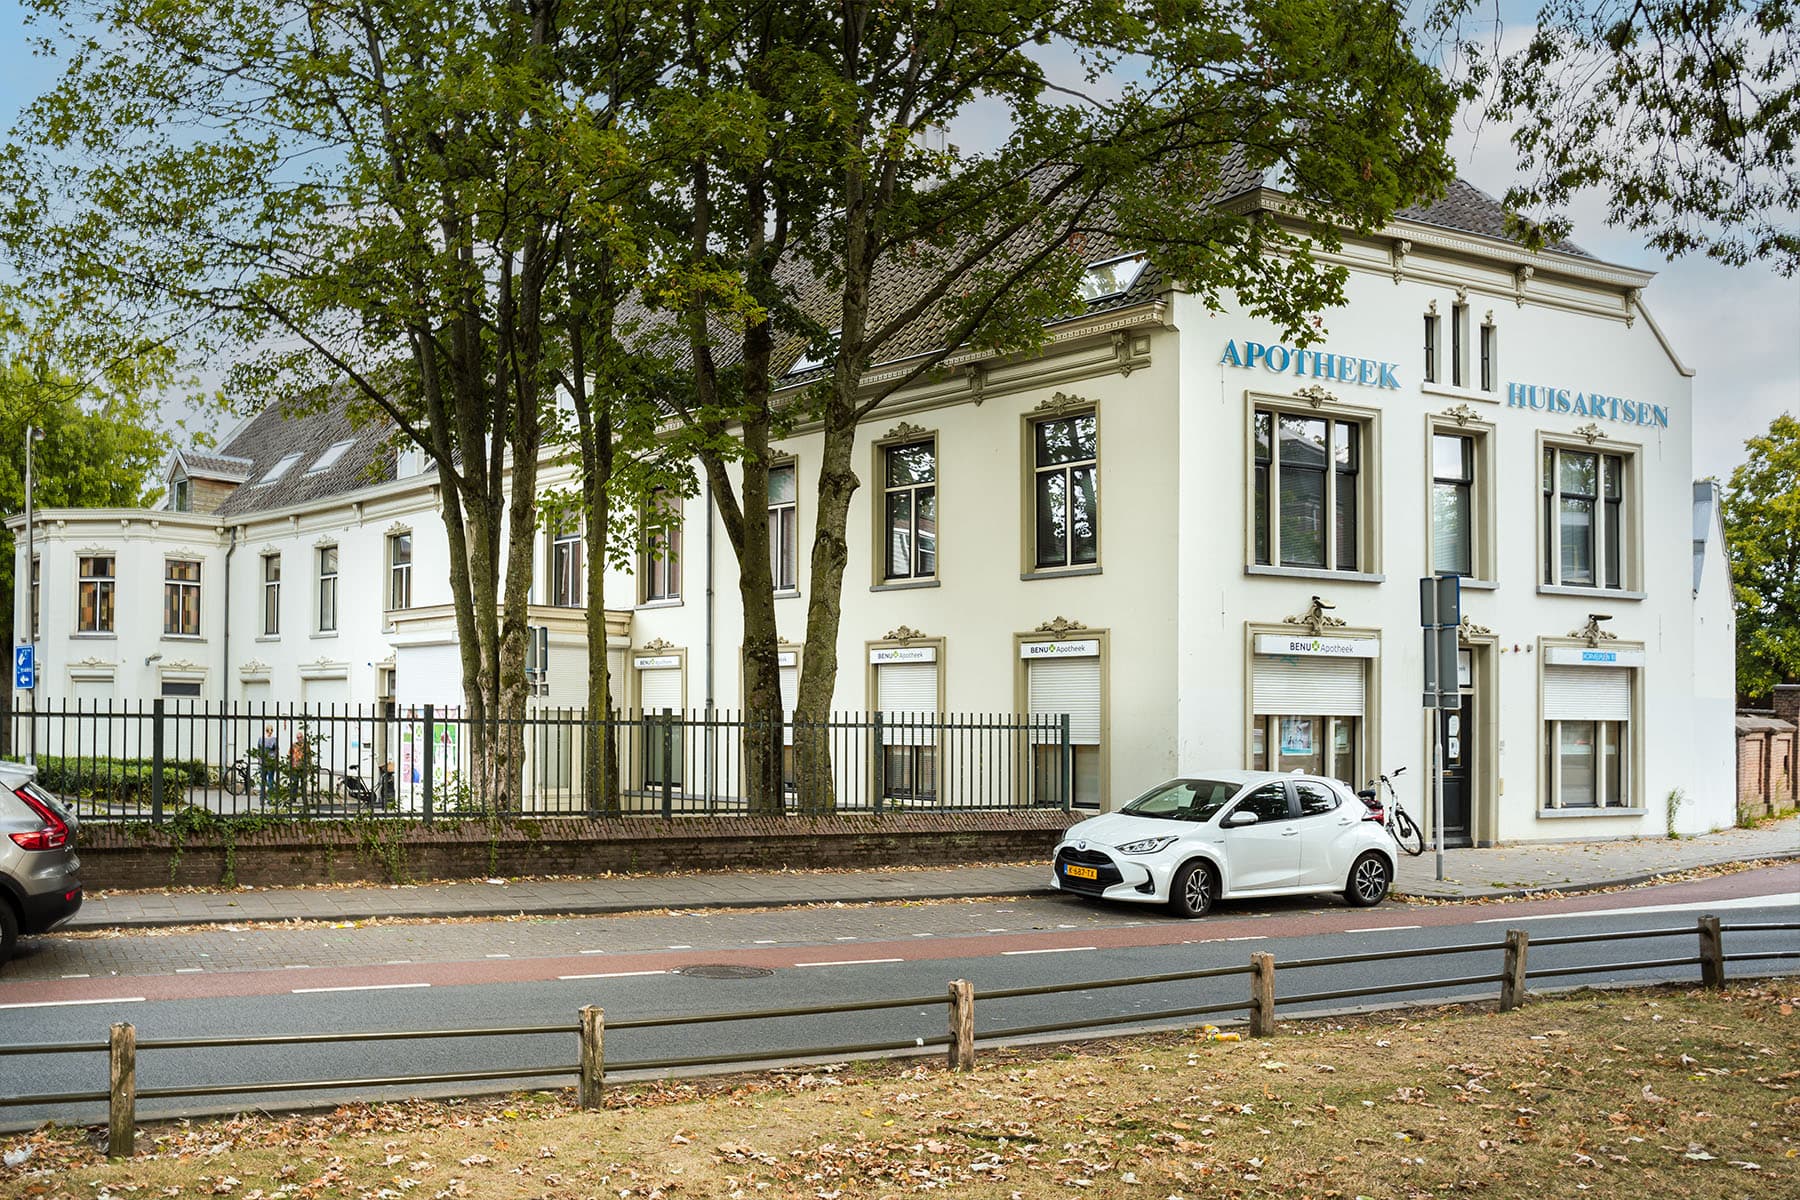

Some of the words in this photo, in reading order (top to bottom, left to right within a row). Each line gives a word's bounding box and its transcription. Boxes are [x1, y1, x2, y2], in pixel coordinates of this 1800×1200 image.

[1219, 338, 1402, 389] APOTHEEK
[1507, 381, 1670, 428] HUISARTSEN
[1030, 646, 1049, 654] BENU
[1056, 643, 1086, 653] Apotheek
[1289, 641, 1312, 652] BENU
[1319, 643, 1354, 654] Apotheek
[877, 652, 893, 660] BENU
